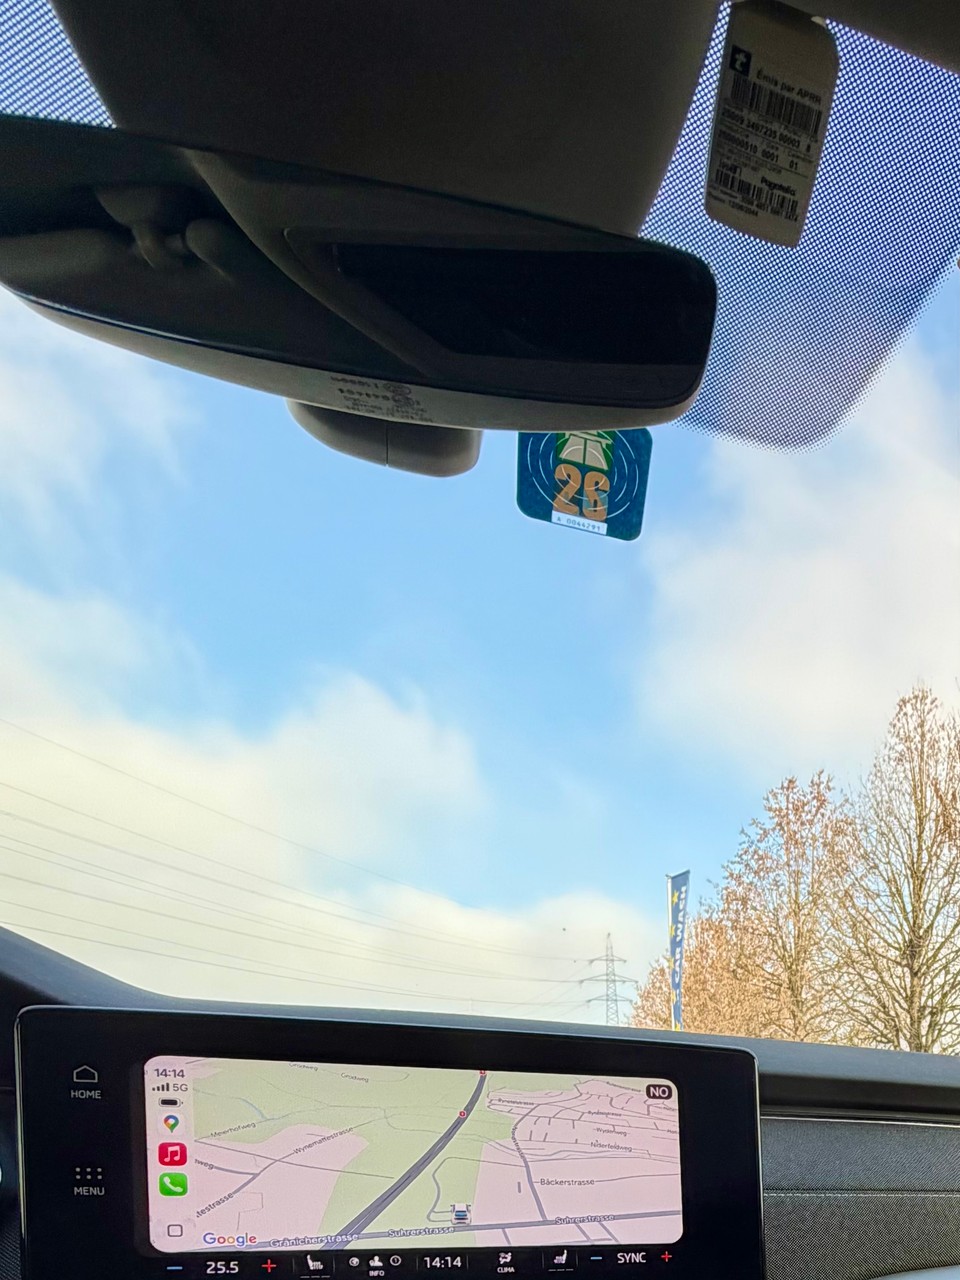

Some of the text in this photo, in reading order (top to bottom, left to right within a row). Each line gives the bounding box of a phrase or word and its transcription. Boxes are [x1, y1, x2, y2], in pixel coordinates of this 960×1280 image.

[153, 1068, 185, 1079] 14:14
[172, 1083, 189, 1092] 5G
[650, 1086, 670, 1099] NO
[70, 1089, 102, 1100] HOME
[73, 1186, 106, 1196] MENU
[554, 1214, 617, 1225] Suhrerstrasse
[388, 1225, 456, 1239] Suhrerstrasse
[202, 1231, 258, 1248] Google
[423, 1256, 462, 1269] 14:14
[616, 1251, 648, 1265] SYNC
[206, 1261, 240, 1275] 25.5
[368, 1269, 386, 1277] INFO
[497, 1266, 516, 1274] CLIMA
